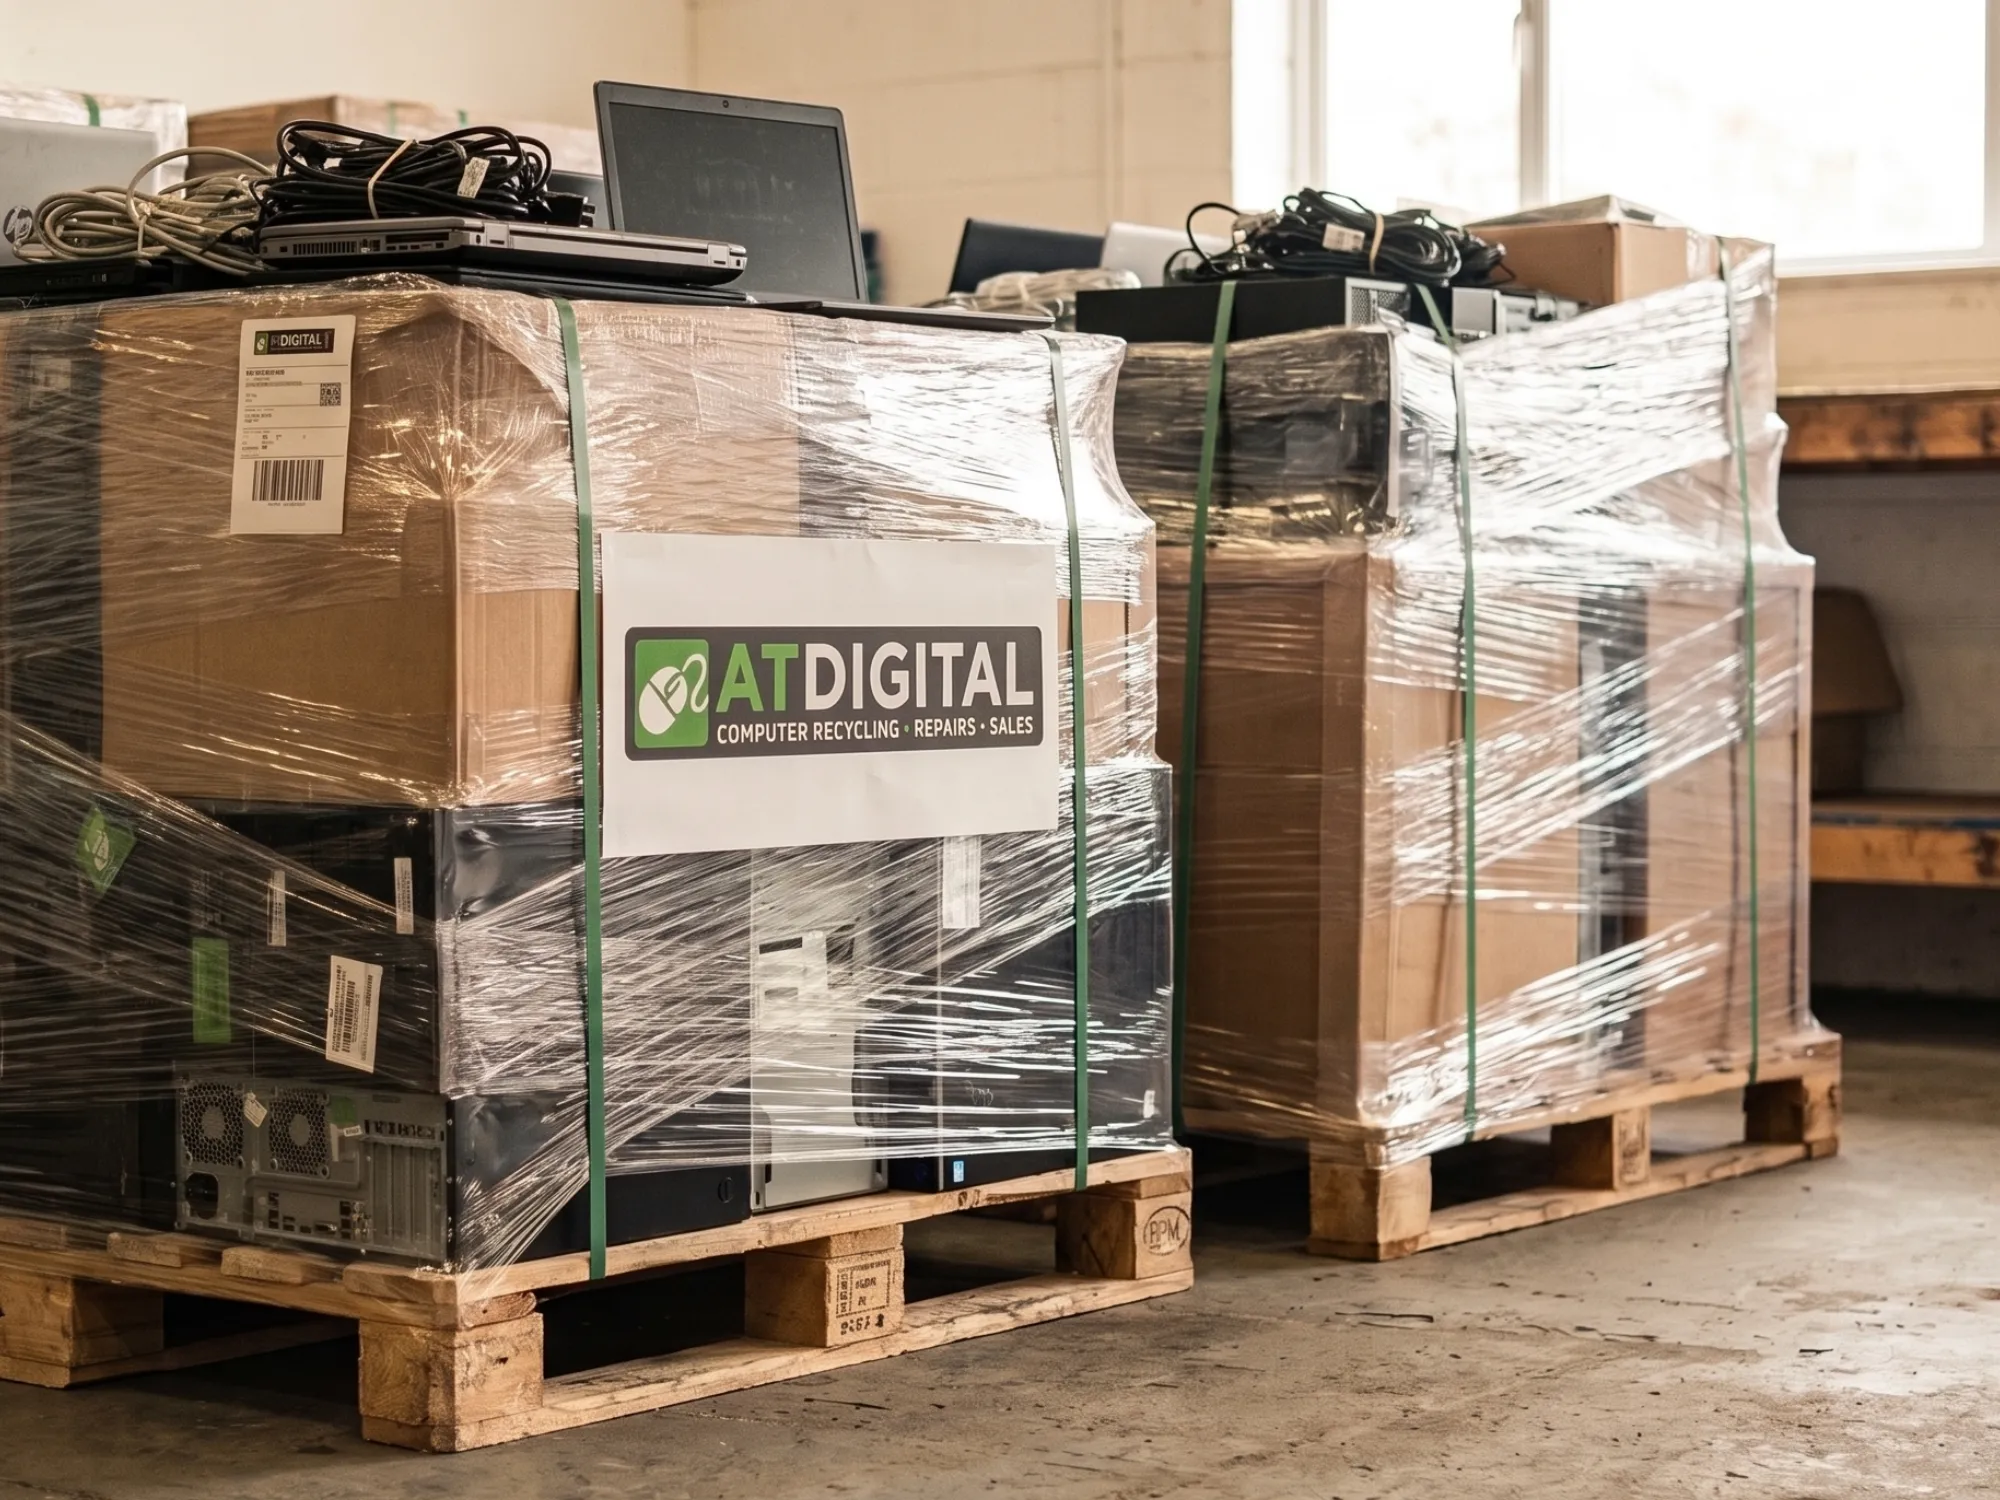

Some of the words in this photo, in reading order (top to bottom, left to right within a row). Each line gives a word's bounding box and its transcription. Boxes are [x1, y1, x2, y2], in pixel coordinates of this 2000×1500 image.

[715, 641, 1034, 713] ATDIGITAL
[716, 722, 808, 745] COMPUTER
[813, 719, 899, 742] RECYCLING
[913, 716, 976, 738] REPAIRS
[989, 715, 1034, 735] SALES
